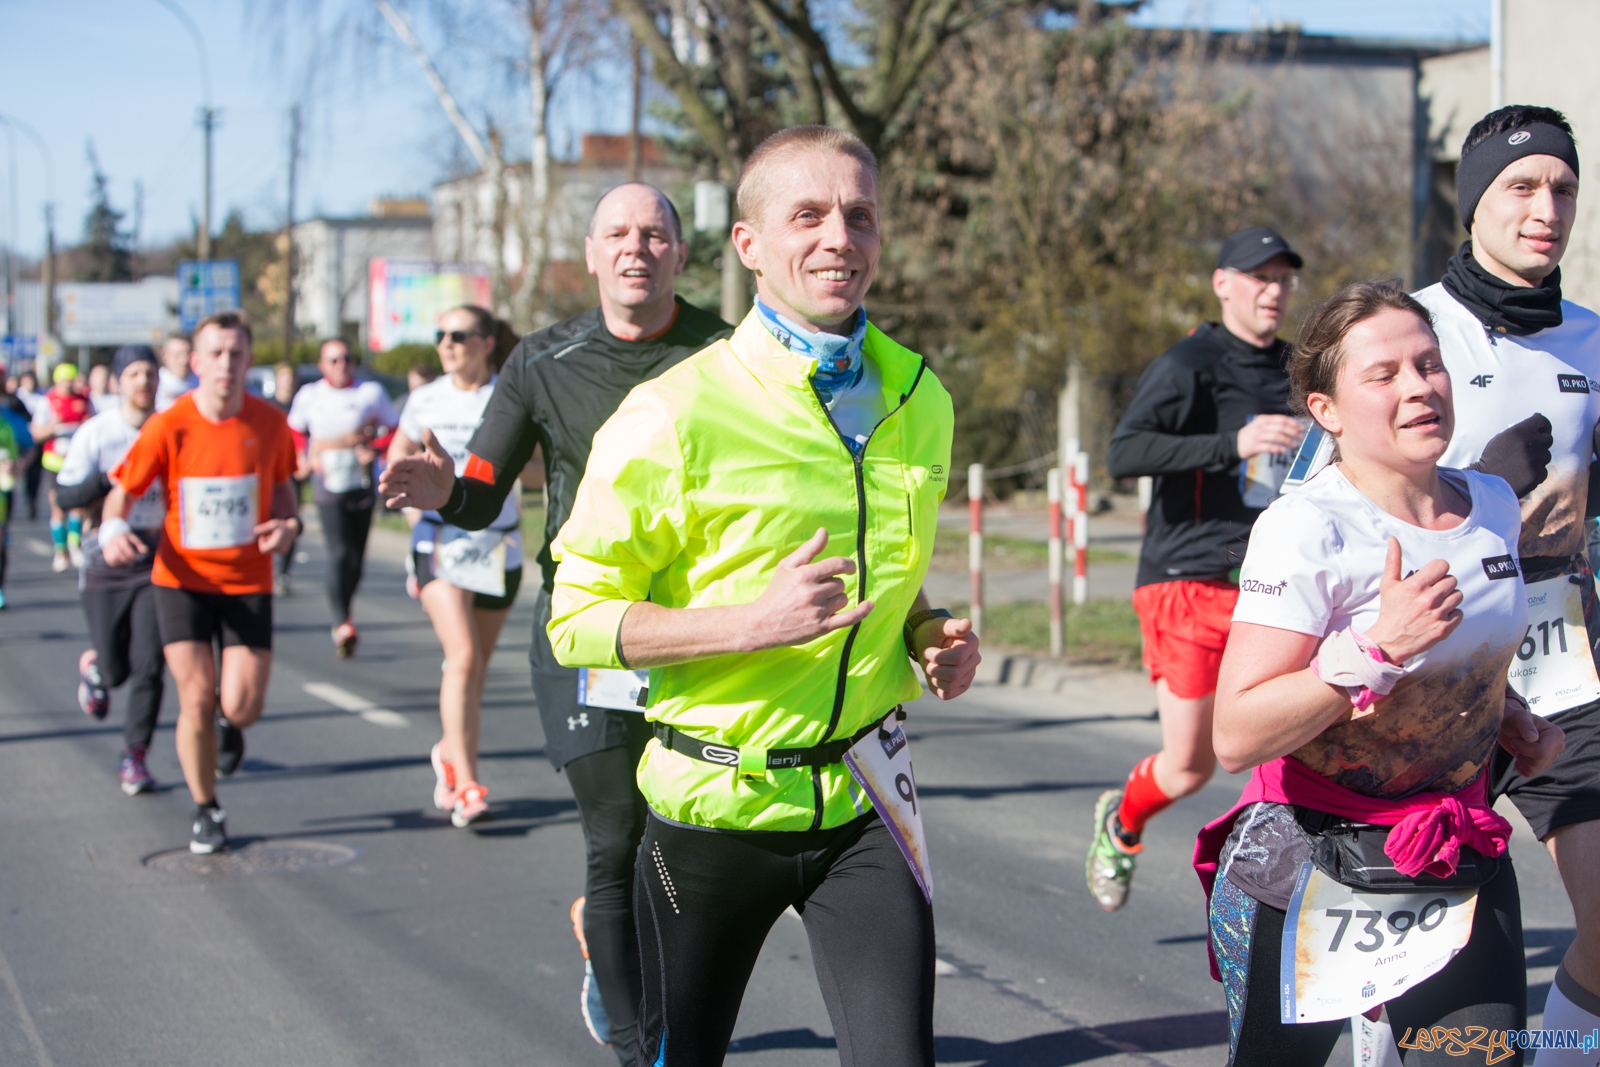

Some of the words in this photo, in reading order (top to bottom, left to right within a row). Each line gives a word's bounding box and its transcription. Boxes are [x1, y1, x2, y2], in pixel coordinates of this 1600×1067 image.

[1469, 374, 1494, 388] 4F
[1507, 666, 1538, 679] ukasz
[768, 754, 801, 767] lenji
[1325, 898, 1449, 953] 7390
[1374, 951, 1407, 968] Anna
